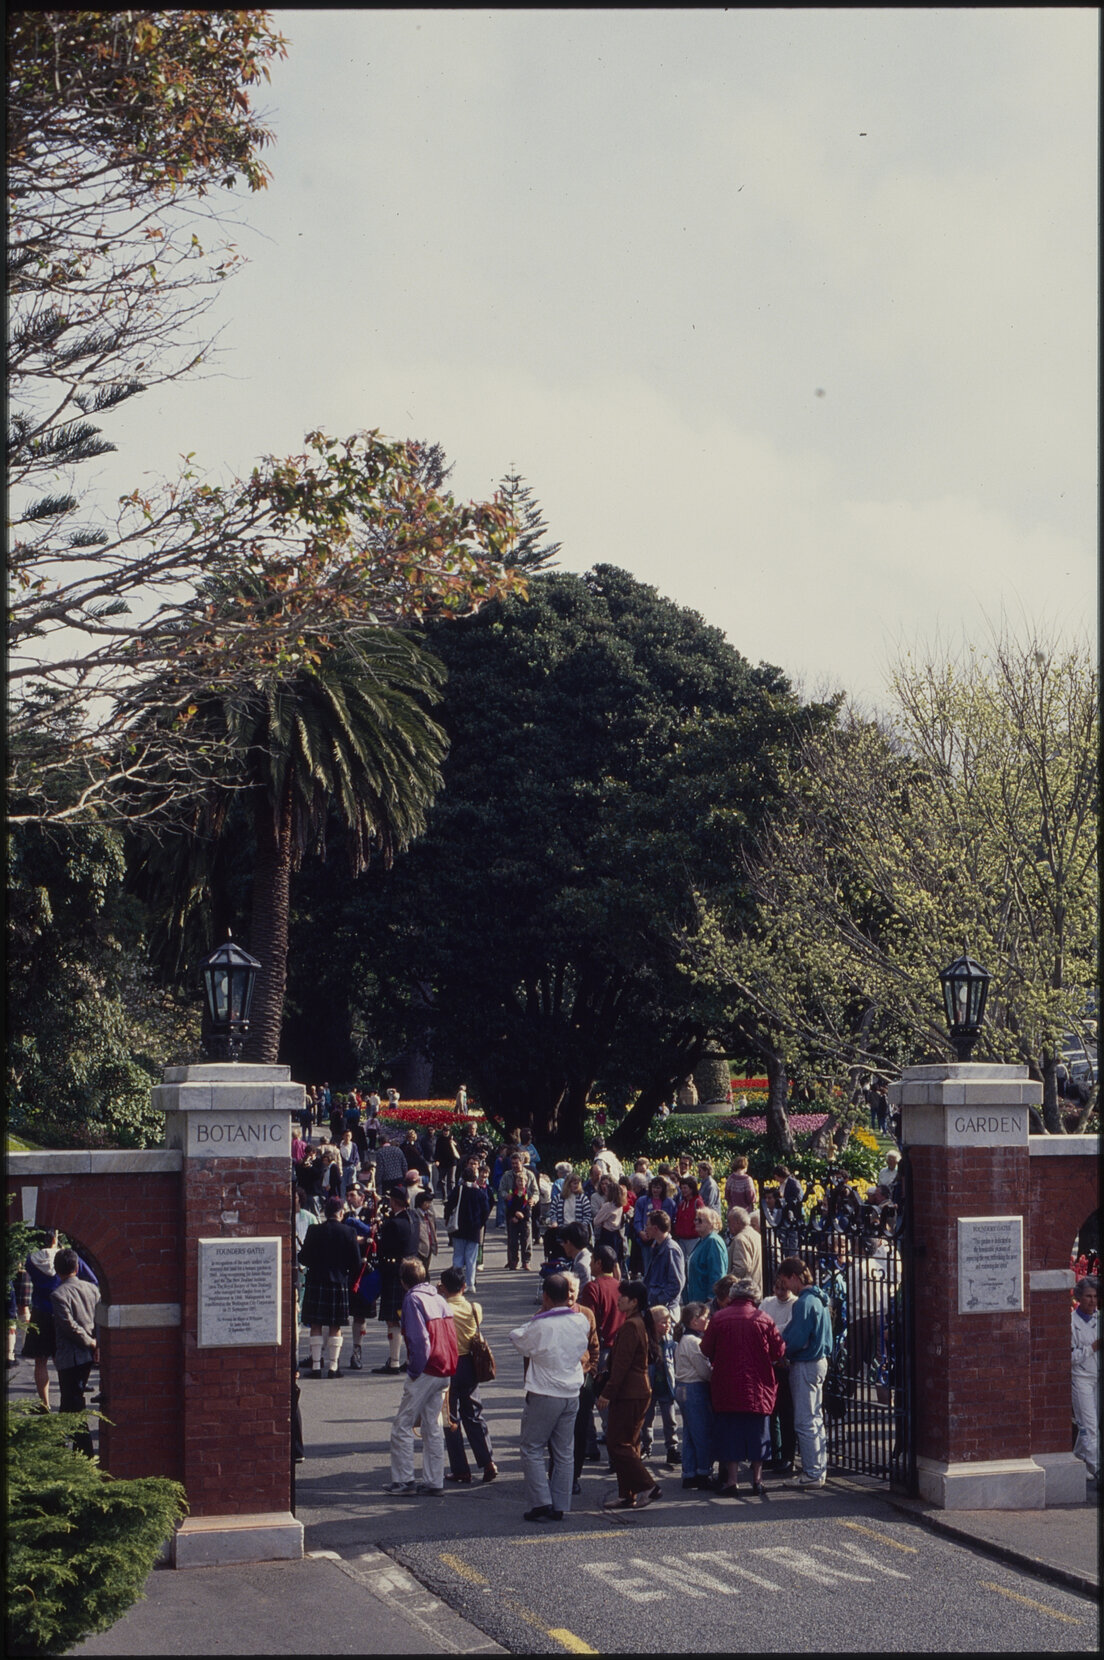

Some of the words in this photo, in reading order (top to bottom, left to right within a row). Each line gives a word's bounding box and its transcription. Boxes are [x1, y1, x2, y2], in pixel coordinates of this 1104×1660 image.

[197, 1124, 282, 1142] BOTANIC
[955, 1117, 1022, 1133] GARDEN
[578, 1543, 911, 1601] ENTRY
